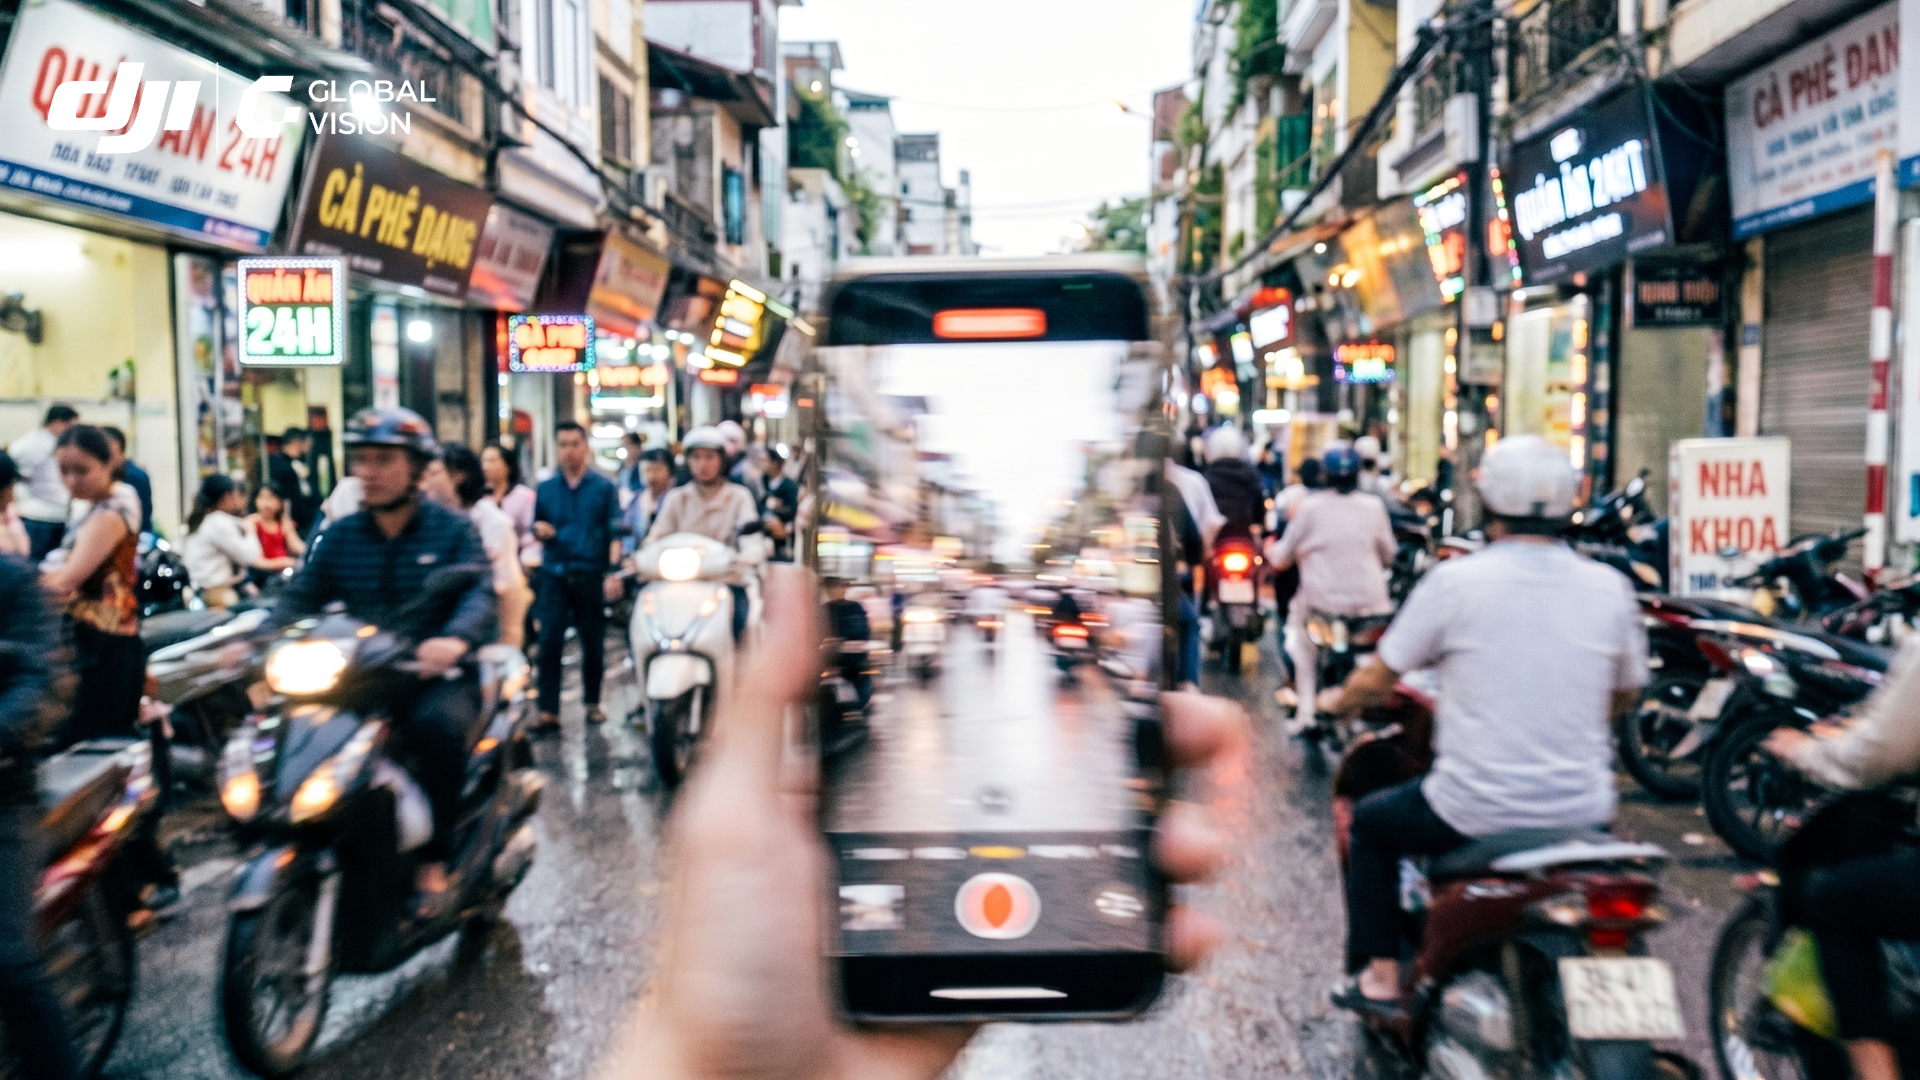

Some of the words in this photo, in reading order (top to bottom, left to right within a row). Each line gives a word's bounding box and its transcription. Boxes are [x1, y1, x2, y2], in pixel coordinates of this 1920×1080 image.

[412, 204, 478, 271] DẠNG
[247, 306, 333, 355] 24H
[1698, 459, 1768, 498] NHA
[1689, 515, 1779, 556] KHOA
